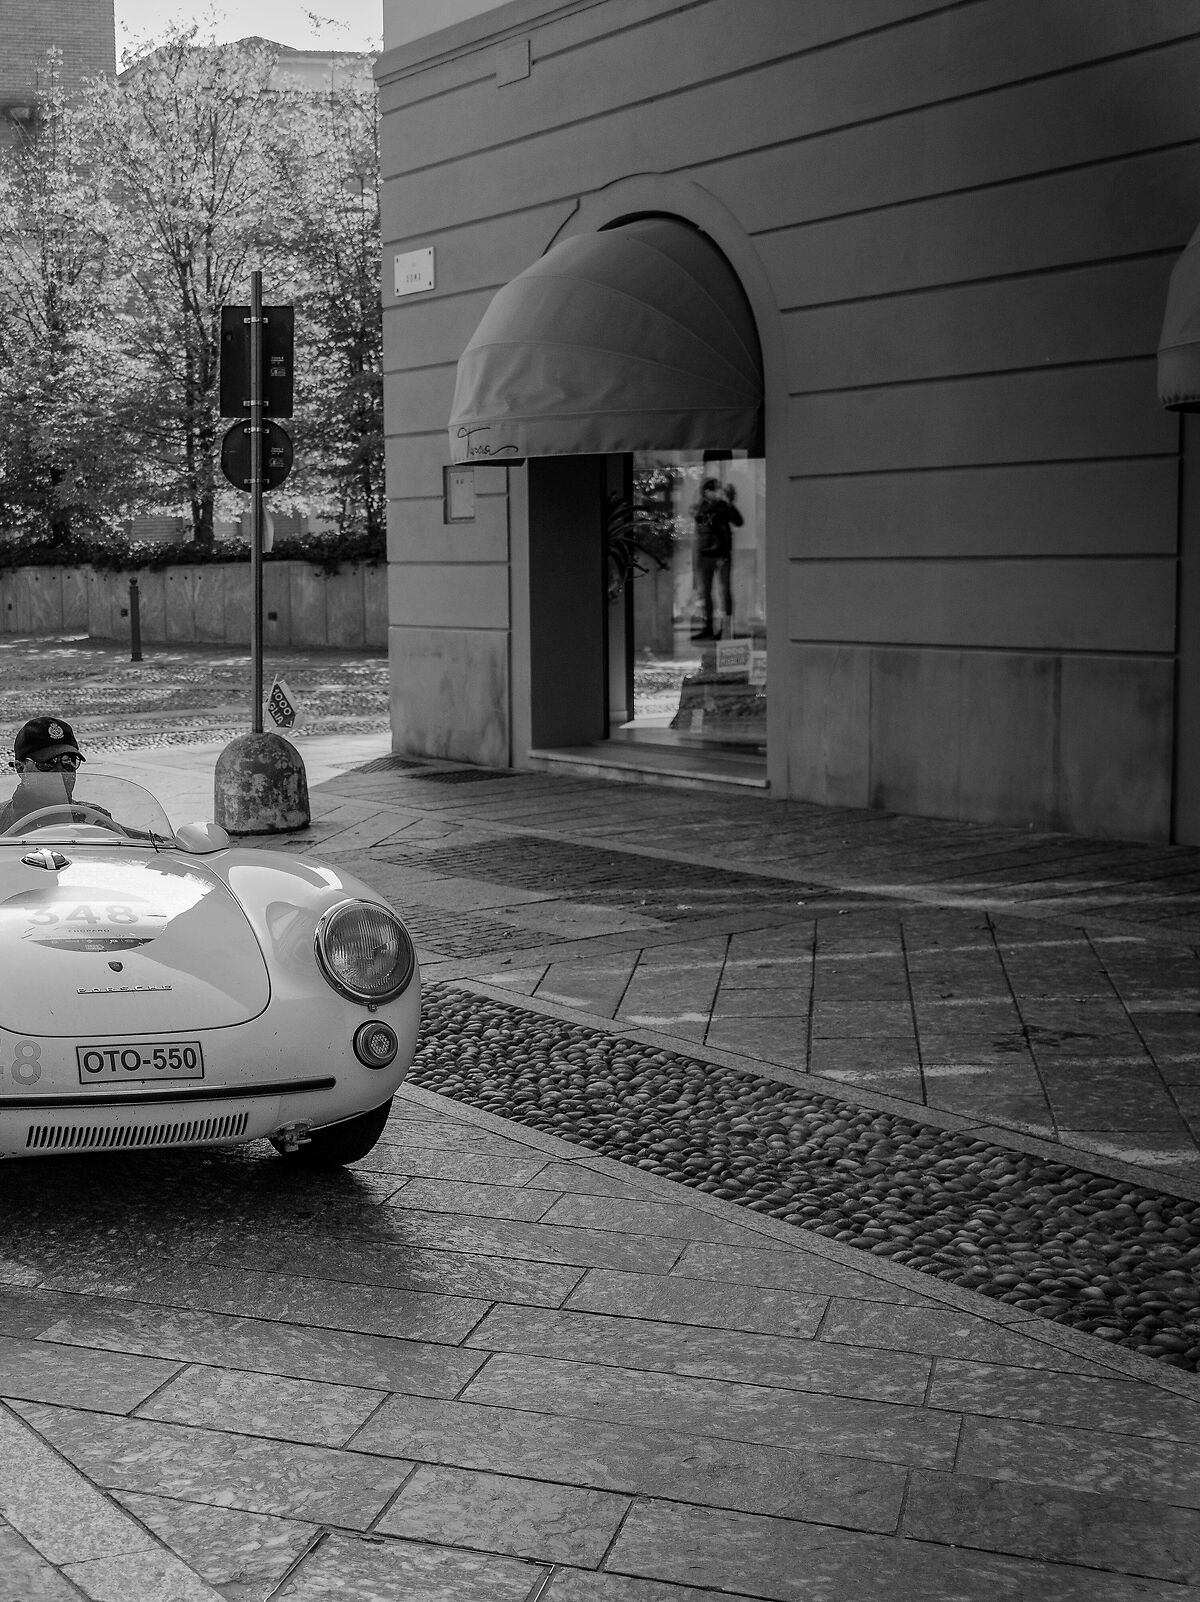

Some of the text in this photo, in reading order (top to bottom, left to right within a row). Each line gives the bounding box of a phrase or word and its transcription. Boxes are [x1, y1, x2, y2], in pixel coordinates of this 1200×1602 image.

[273, 689, 292, 716] 1000
[25, 903, 139, 926] 348
[83, 1047, 197, 1074] OTO-550
